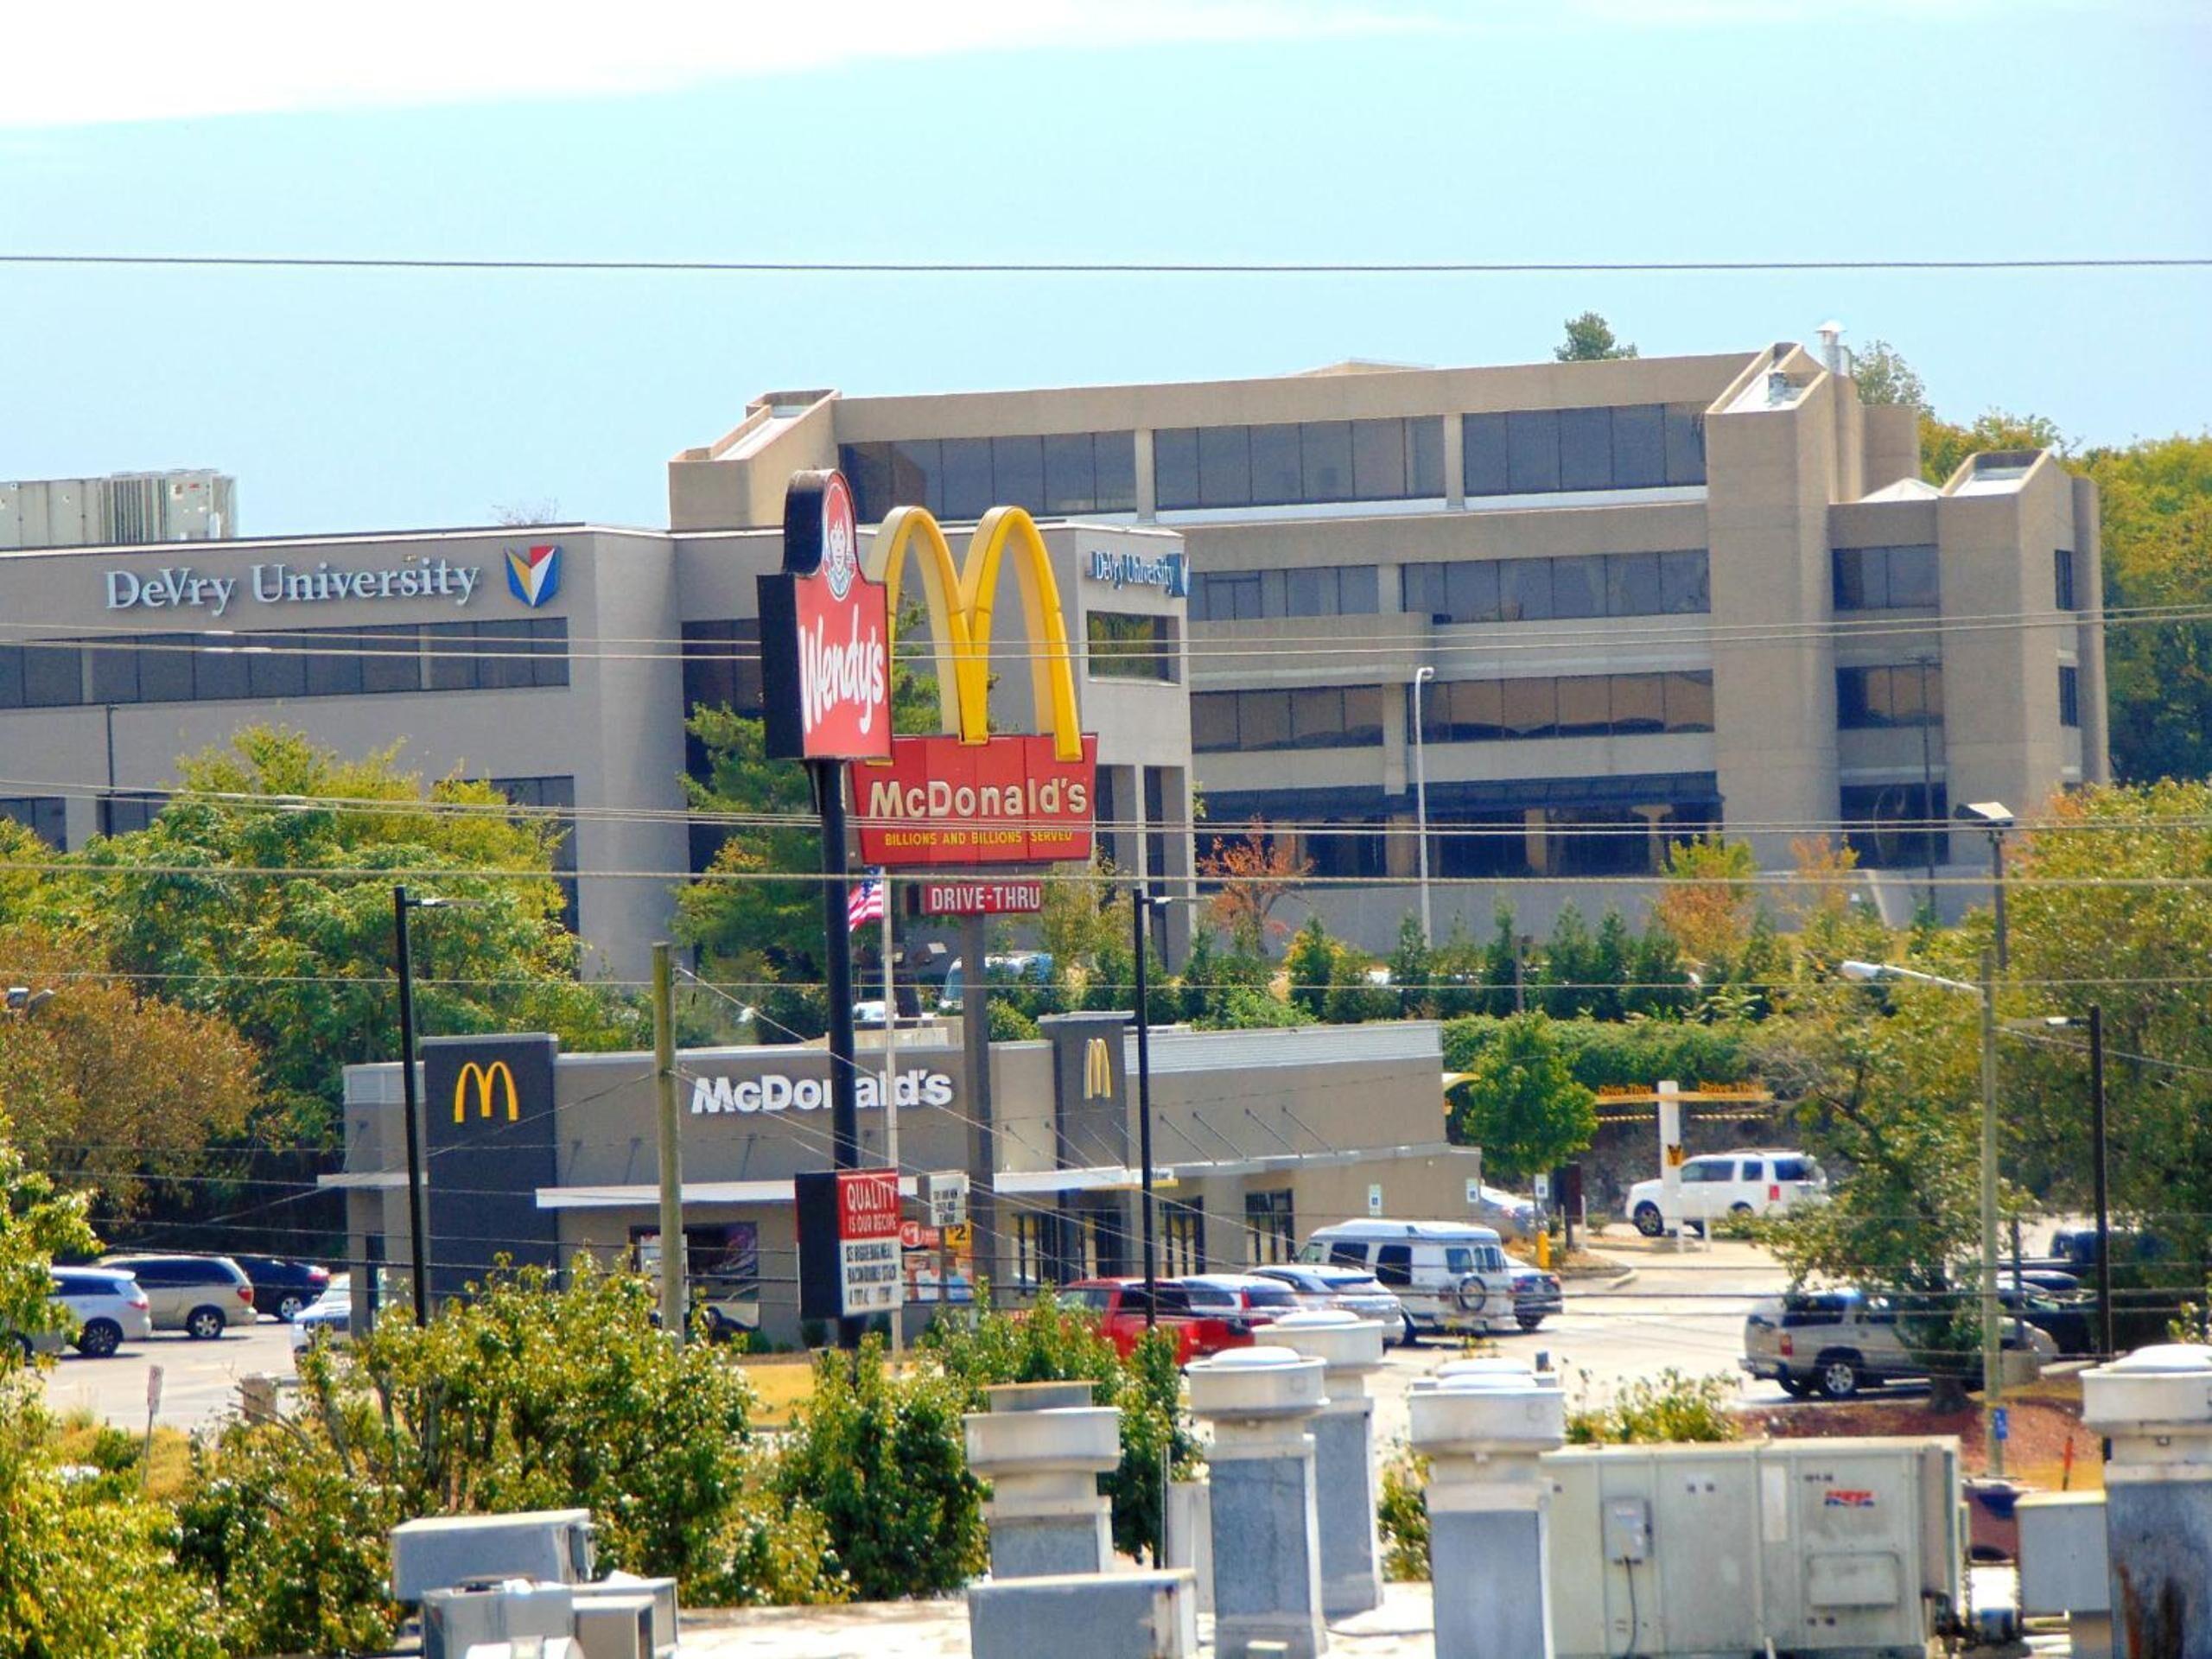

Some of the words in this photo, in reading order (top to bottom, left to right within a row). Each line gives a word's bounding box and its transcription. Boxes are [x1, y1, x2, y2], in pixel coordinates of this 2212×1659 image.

[105, 567, 236, 616] DeVry
[250, 557, 480, 606] University
[1096, 551, 1122, 590] DeVry
[1122, 553, 1174, 594] University
[799, 603, 884, 734] Wendy's
[869, 778, 1086, 818] McDonald's
[885, 831, 937, 846] BILLIONS
[942, 831, 965, 845] AND
[971, 830, 1022, 845] BILLIONS
[1029, 830, 1072, 842] SERVED
[931, 886, 1040, 911] DRIVE-THRU
[847, 1181, 894, 1211] QUALITY
[849, 1217, 856, 1233] IS
[857, 1215, 872, 1232] OUR
[873, 1213, 897, 1231] RECIPE
